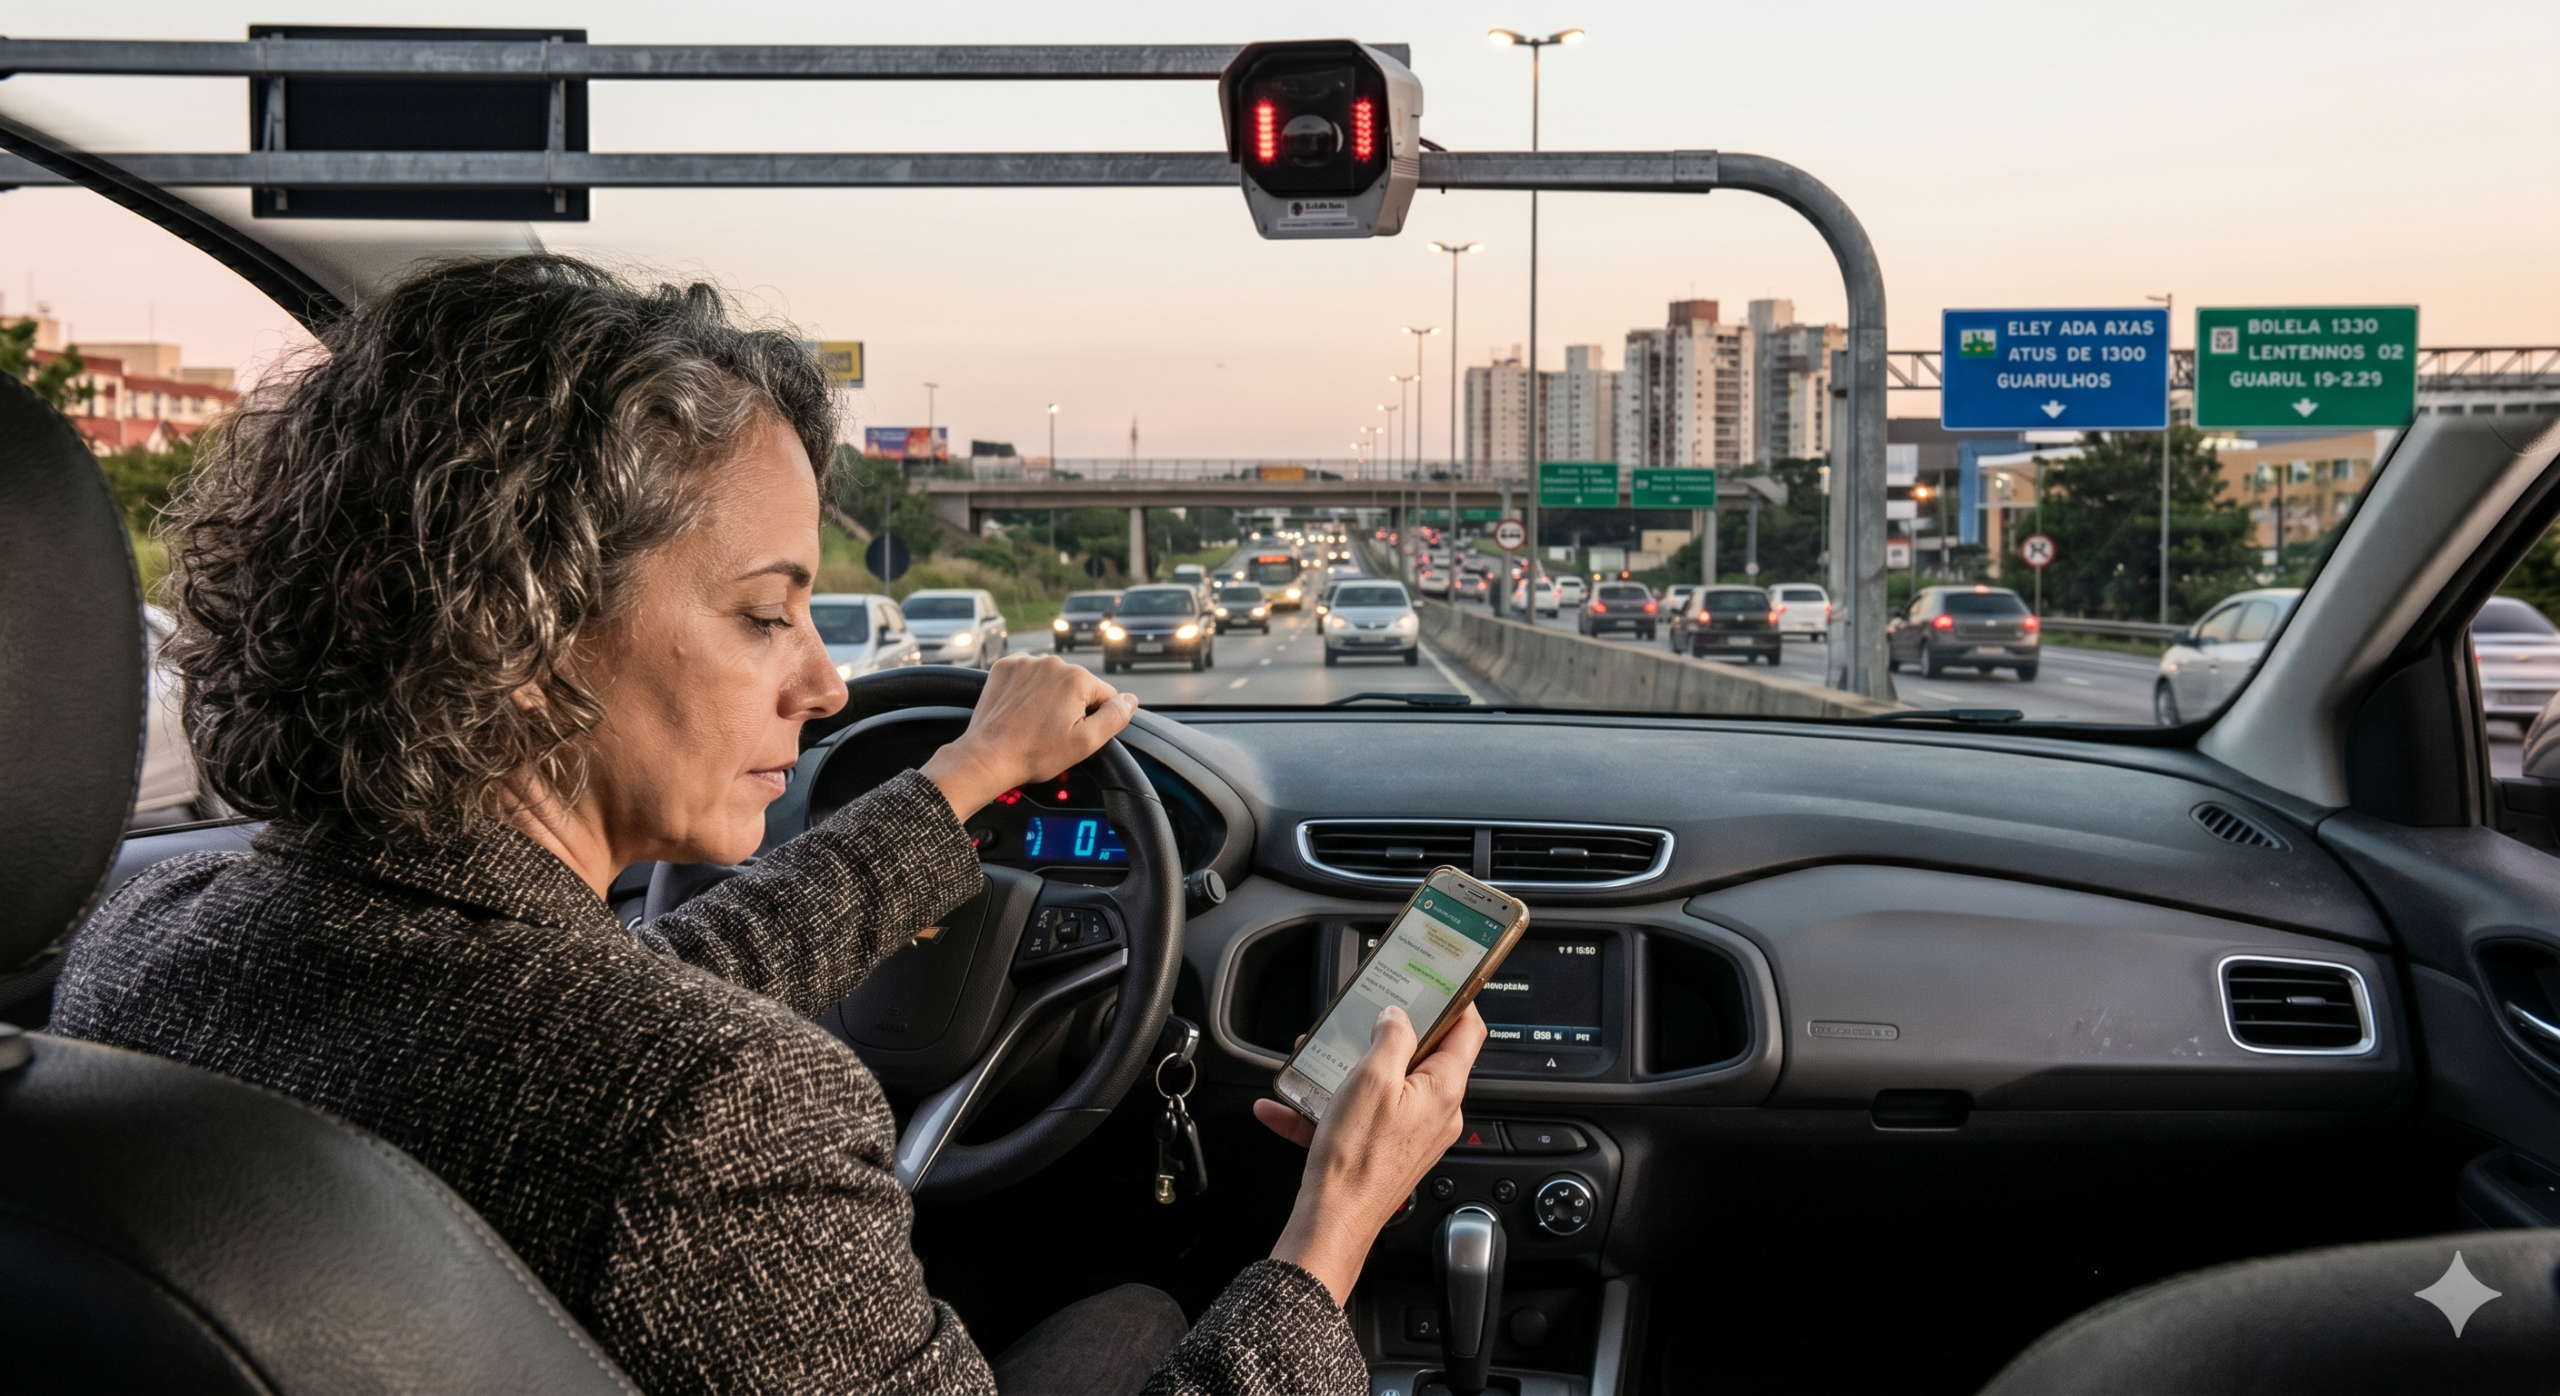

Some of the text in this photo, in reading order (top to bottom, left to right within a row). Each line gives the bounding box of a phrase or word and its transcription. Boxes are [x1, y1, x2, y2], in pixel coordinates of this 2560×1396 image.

[2007, 320, 2155, 336] ELEY ADA AXAS
[2247, 318, 2379, 335] BOLELA 1330
[2008, 346, 2147, 362] ATUS DE 1300
[2248, 344, 2404, 361] LENTENNOS 02
[1996, 372, 2112, 389] GUARULHOS
[2229, 370, 2307, 388] GUARUL
[1074, 820, 1098, 857] 0
